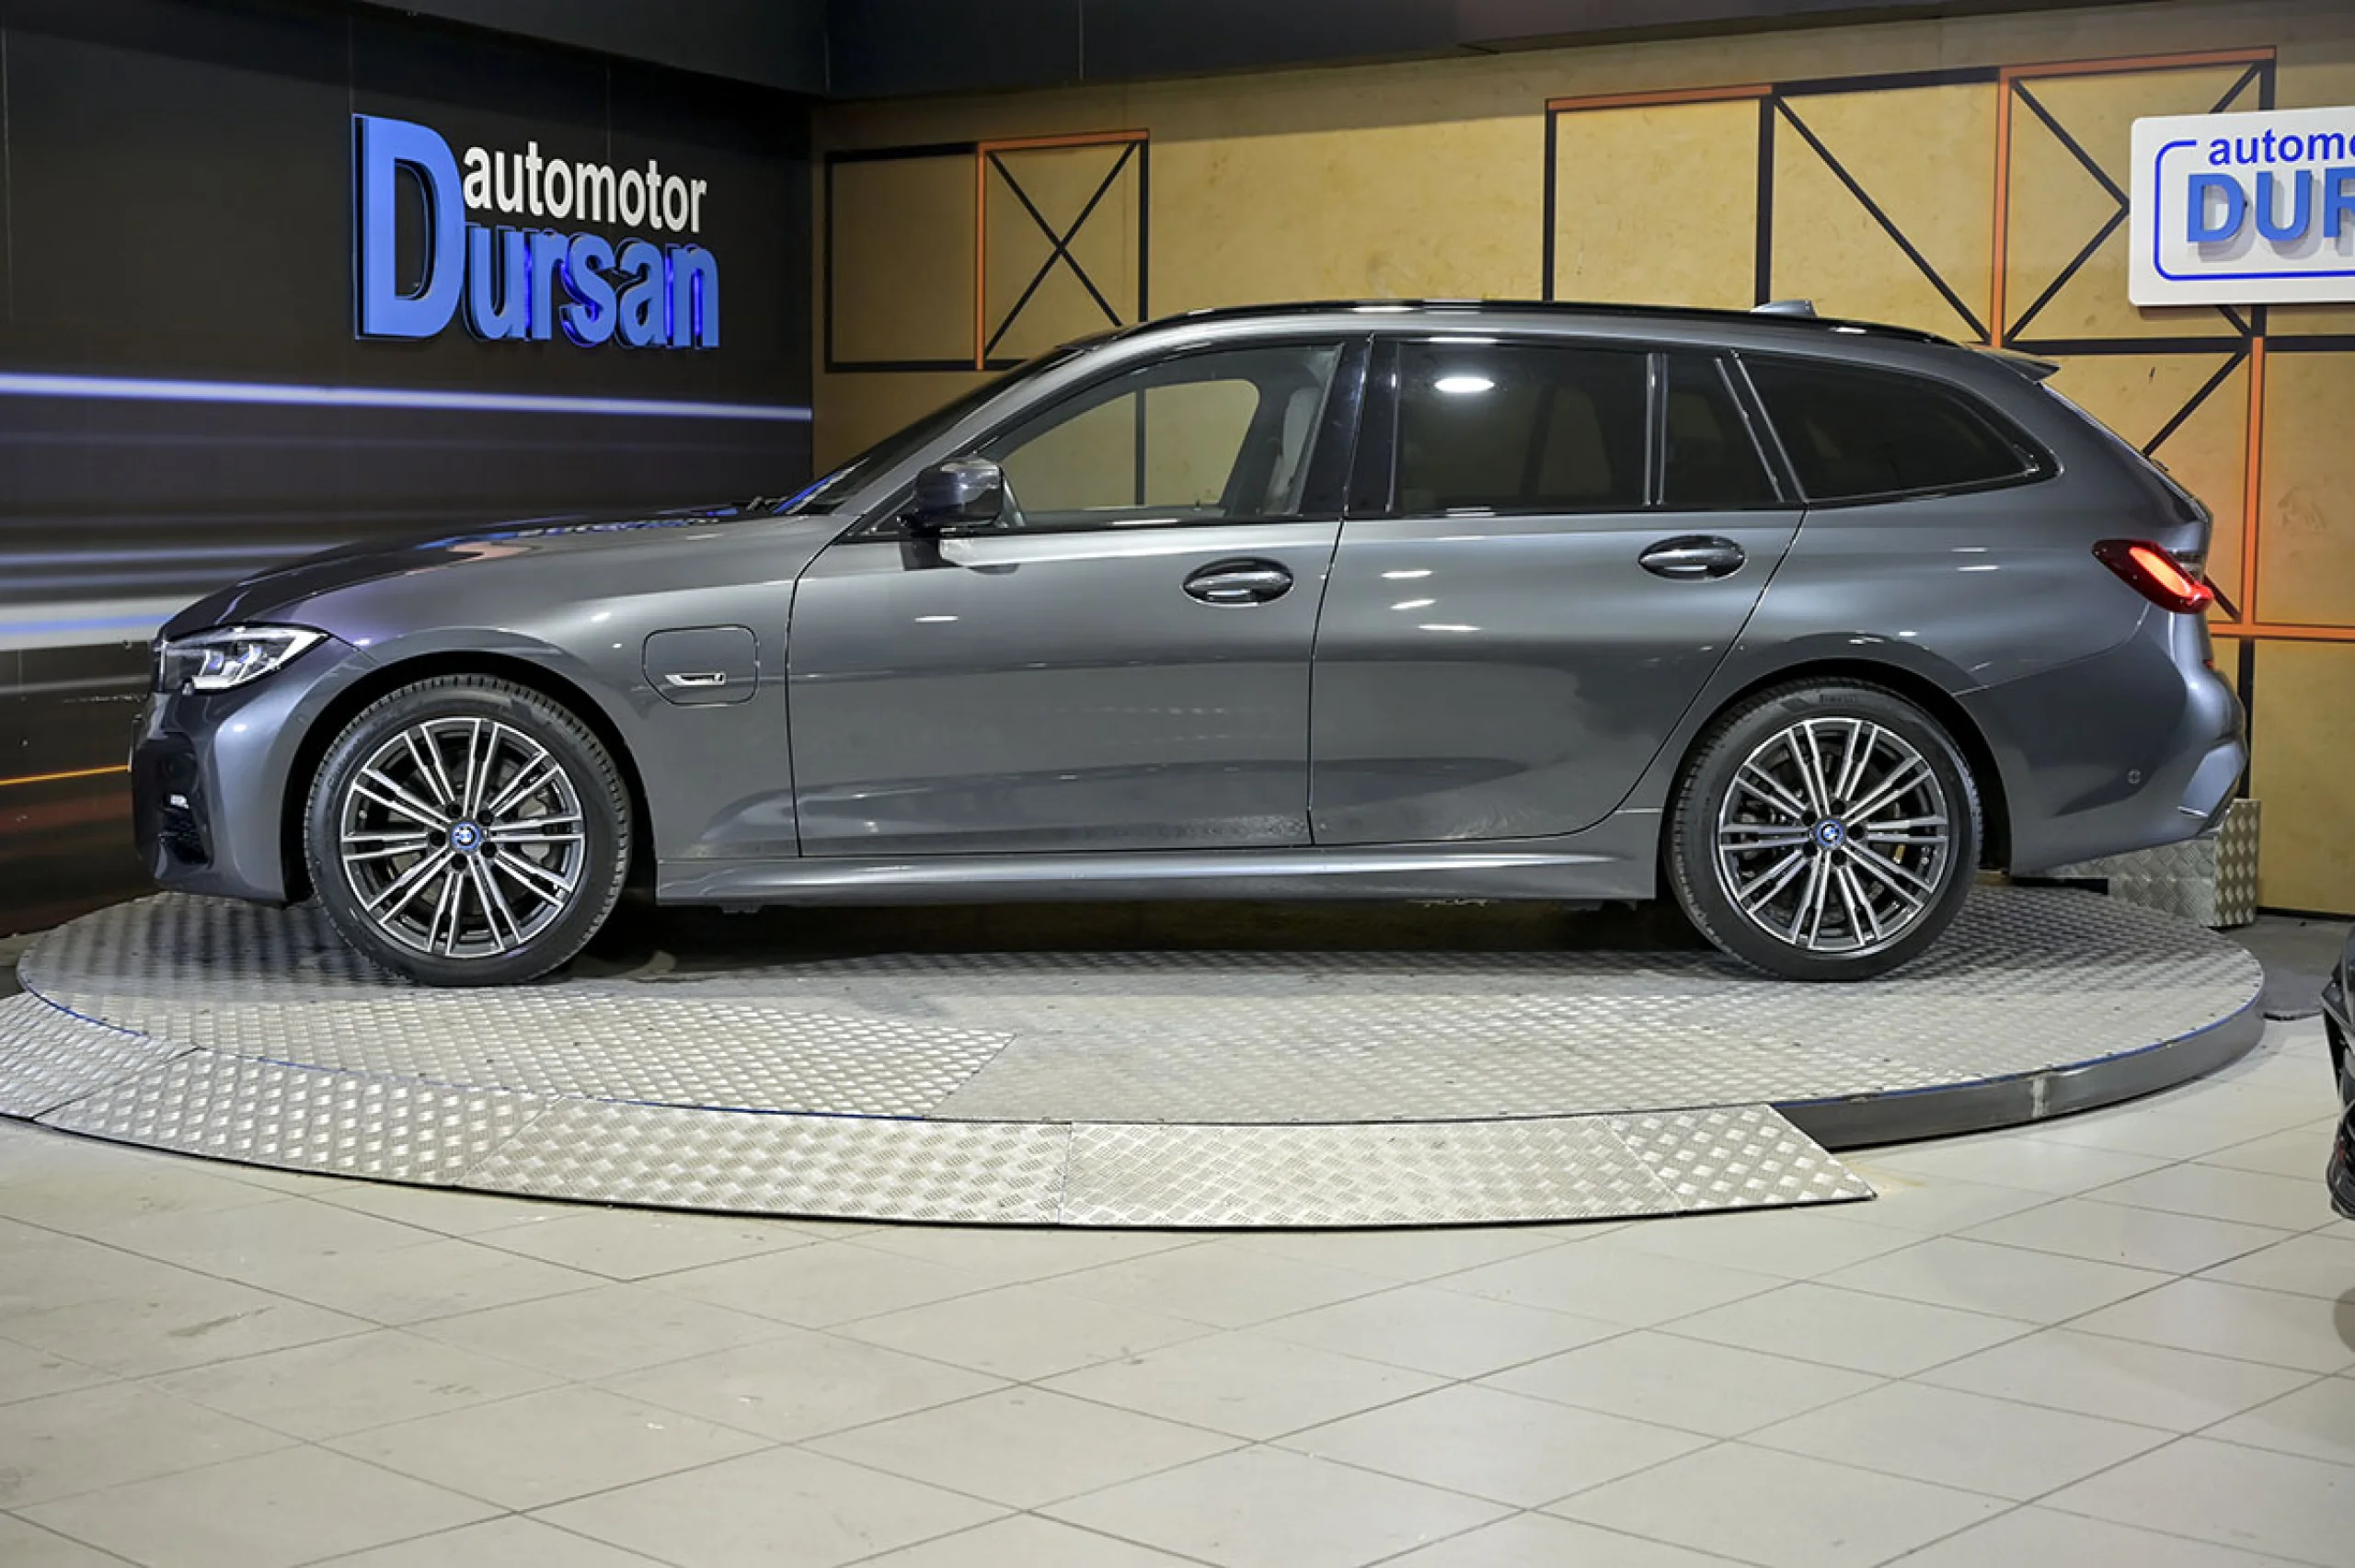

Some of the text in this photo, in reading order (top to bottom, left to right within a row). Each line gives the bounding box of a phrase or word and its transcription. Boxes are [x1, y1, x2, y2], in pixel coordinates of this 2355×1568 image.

[463, 141, 707, 233] automotor
[2209, 129, 2355, 166] autom
[351, 113, 720, 349] Dursan
